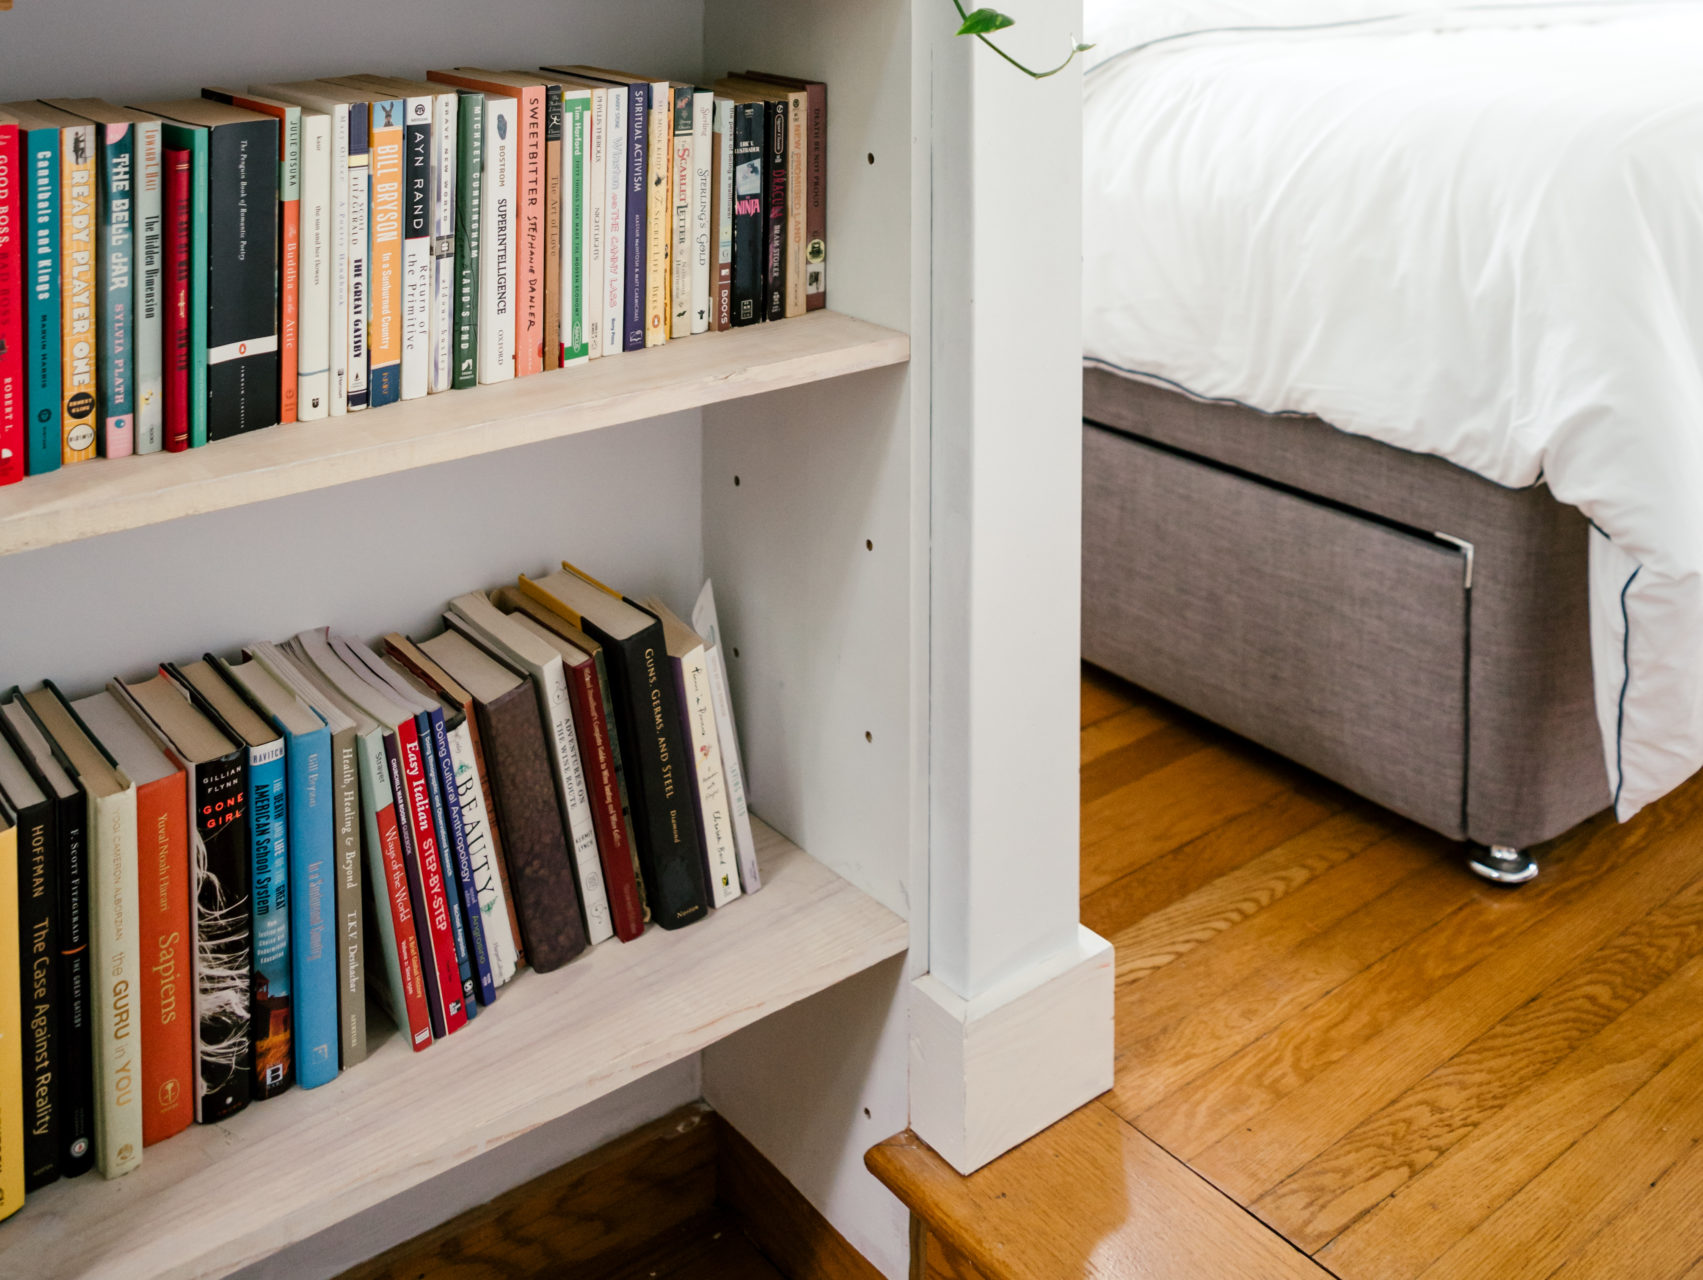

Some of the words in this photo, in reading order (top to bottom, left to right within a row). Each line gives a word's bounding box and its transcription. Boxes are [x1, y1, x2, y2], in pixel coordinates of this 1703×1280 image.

[573, 105, 583, 120] Tim
[633, 90, 644, 140] SPIRITUAL
[240, 140, 248, 152] The
[289, 120, 298, 147] JULIE
[413, 132, 425, 167] AYN
[472, 106, 481, 164] MICHAEL
[527, 97, 539, 207] SWEETBITTER
[573, 122, 583, 156] Harford
[0, 155, 9, 200] GOOD
[111, 153, 130, 193] THE
[238, 153, 248, 179] Penguin
[289, 150, 297, 187] OTSUKA
[377, 144, 400, 177] BILL
[498, 145, 506, 187] BOSTROM
[633, 143, 643, 192] ACTIVISM
[677, 147, 690, 202] SCARLET
[726, 153, 735, 174] being
[36, 150, 52, 224] Cannibals
[238, 199, 248, 207] of
[240, 181, 248, 198] Book
[413, 178, 424, 229] RAND
[550, 176, 559, 195] The
[813, 175, 821, 208] PROUD
[72, 169, 90, 242] READY
[111, 198, 130, 246] BELL
[144, 215, 160, 232] The
[240, 208, 248, 238] Romantic
[351, 177, 359, 246] FITZGERALD
[376, 182, 399, 243] BRYSON
[470, 172, 480, 258] CUNNINGHAM
[550, 199, 559, 215] Art
[550, 218, 559, 229] of
[676, 203, 689, 244] LETTER
[735, 198, 761, 216] NINJA
[37, 228, 52, 255] and
[144, 233, 160, 266] Hidden
[238, 240, 248, 261] Poetry
[550, 233, 558, 257] Love
[696, 233, 709, 266] GOLD
[772, 224, 781, 248] BRAM
[109, 252, 129, 292] JAR
[287, 242, 297, 289] Buddha
[353, 258, 363, 279] THE
[382, 252, 392, 262] In
[407, 253, 417, 276] the
[496, 198, 508, 315] SUPERINTELLIGENCE
[772, 249, 780, 277] STOKER
[36, 259, 53, 301] Kings
[72, 251, 91, 335] PLAYER
[144, 268, 160, 319] Dimension
[353, 281, 363, 316] GREAT
[381, 270, 393, 315] Sunburned
[418, 264, 429, 313] Return
[460, 270, 471, 318] LAND'S
[406, 283, 418, 350] Primitive
[526, 278, 538, 332] DANLER
[114, 303, 125, 354] SYLVIA
[285, 319, 296, 349] Attic
[353, 318, 363, 359] GATSBY
[379, 316, 392, 350] Country
[418, 321, 428, 336] of
[460, 325, 470, 350] END
[72, 341, 91, 387] ONE
[114, 359, 125, 405] PLATH
[3, 377, 13, 420] ROBERT
[644, 647, 656, 688] GUNS,
[650, 688, 664, 734] GERMS,
[434, 720, 449, 758] Doing
[555, 720, 567, 746] THE
[659, 736, 669, 764] AND
[253, 747, 283, 764] RAVITCH
[341, 747, 354, 789] Health,
[375, 751, 386, 784] Strayer
[406, 740, 420, 776] Easy
[559, 744, 573, 776] WINE
[564, 717, 584, 788] ADVENTURES
[578, 788, 587, 805] ON
[202, 765, 242, 785] GILLIAN
[206, 777, 239, 794] FLYNN
[273, 776, 284, 794] THE
[390, 758, 402, 792] CHURCHILL
[441, 757, 459, 803] Cultural
[565, 775, 578, 812] ROUTE
[661, 764, 675, 800] STEEL
[202, 792, 244, 816] GONE
[254, 783, 271, 838] AMERICAN
[273, 792, 284, 821] DEATH
[342, 790, 355, 835] Healing
[395, 790, 405, 805] WAR
[398, 803, 407, 825] ROOMS
[412, 776, 430, 832] Italian
[156, 812, 169, 844] Yuval
[206, 809, 242, 829] GIRL
[457, 776, 495, 894] BEAUTY
[31, 824, 45, 898] HOFFMAN
[70, 841, 80, 876] SCOTT
[157, 845, 170, 876] Noah
[255, 838, 272, 876] School
[274, 838, 285, 857] LIFE
[345, 836, 353, 850] &
[385, 825, 398, 860] Ways
[449, 805, 471, 883] Anthropology
[342, 851, 357, 889] Beyond
[391, 859, 402, 872] of
[393, 871, 404, 889] the
[422, 837, 448, 931] STEP-BY-STEP
[71, 877, 80, 943] FITZGERALD
[157, 877, 170, 912] Harari
[254, 876, 272, 916] System
[276, 884, 286, 911] GREAT
[395, 886, 411, 923] World
[32, 916, 49, 954] The
[472, 915, 486, 965] Angrosino
[34, 956, 50, 999] Case
[111, 951, 126, 977] the
[151, 931, 181, 1025] Sapiens
[348, 942, 360, 993] Desikachar
[112, 979, 131, 1041] GURU
[31, 1002, 51, 1072] Against
[113, 1042, 129, 1060] in
[114, 1059, 133, 1107] YOU
[32, 1071, 52, 1135] Reality
